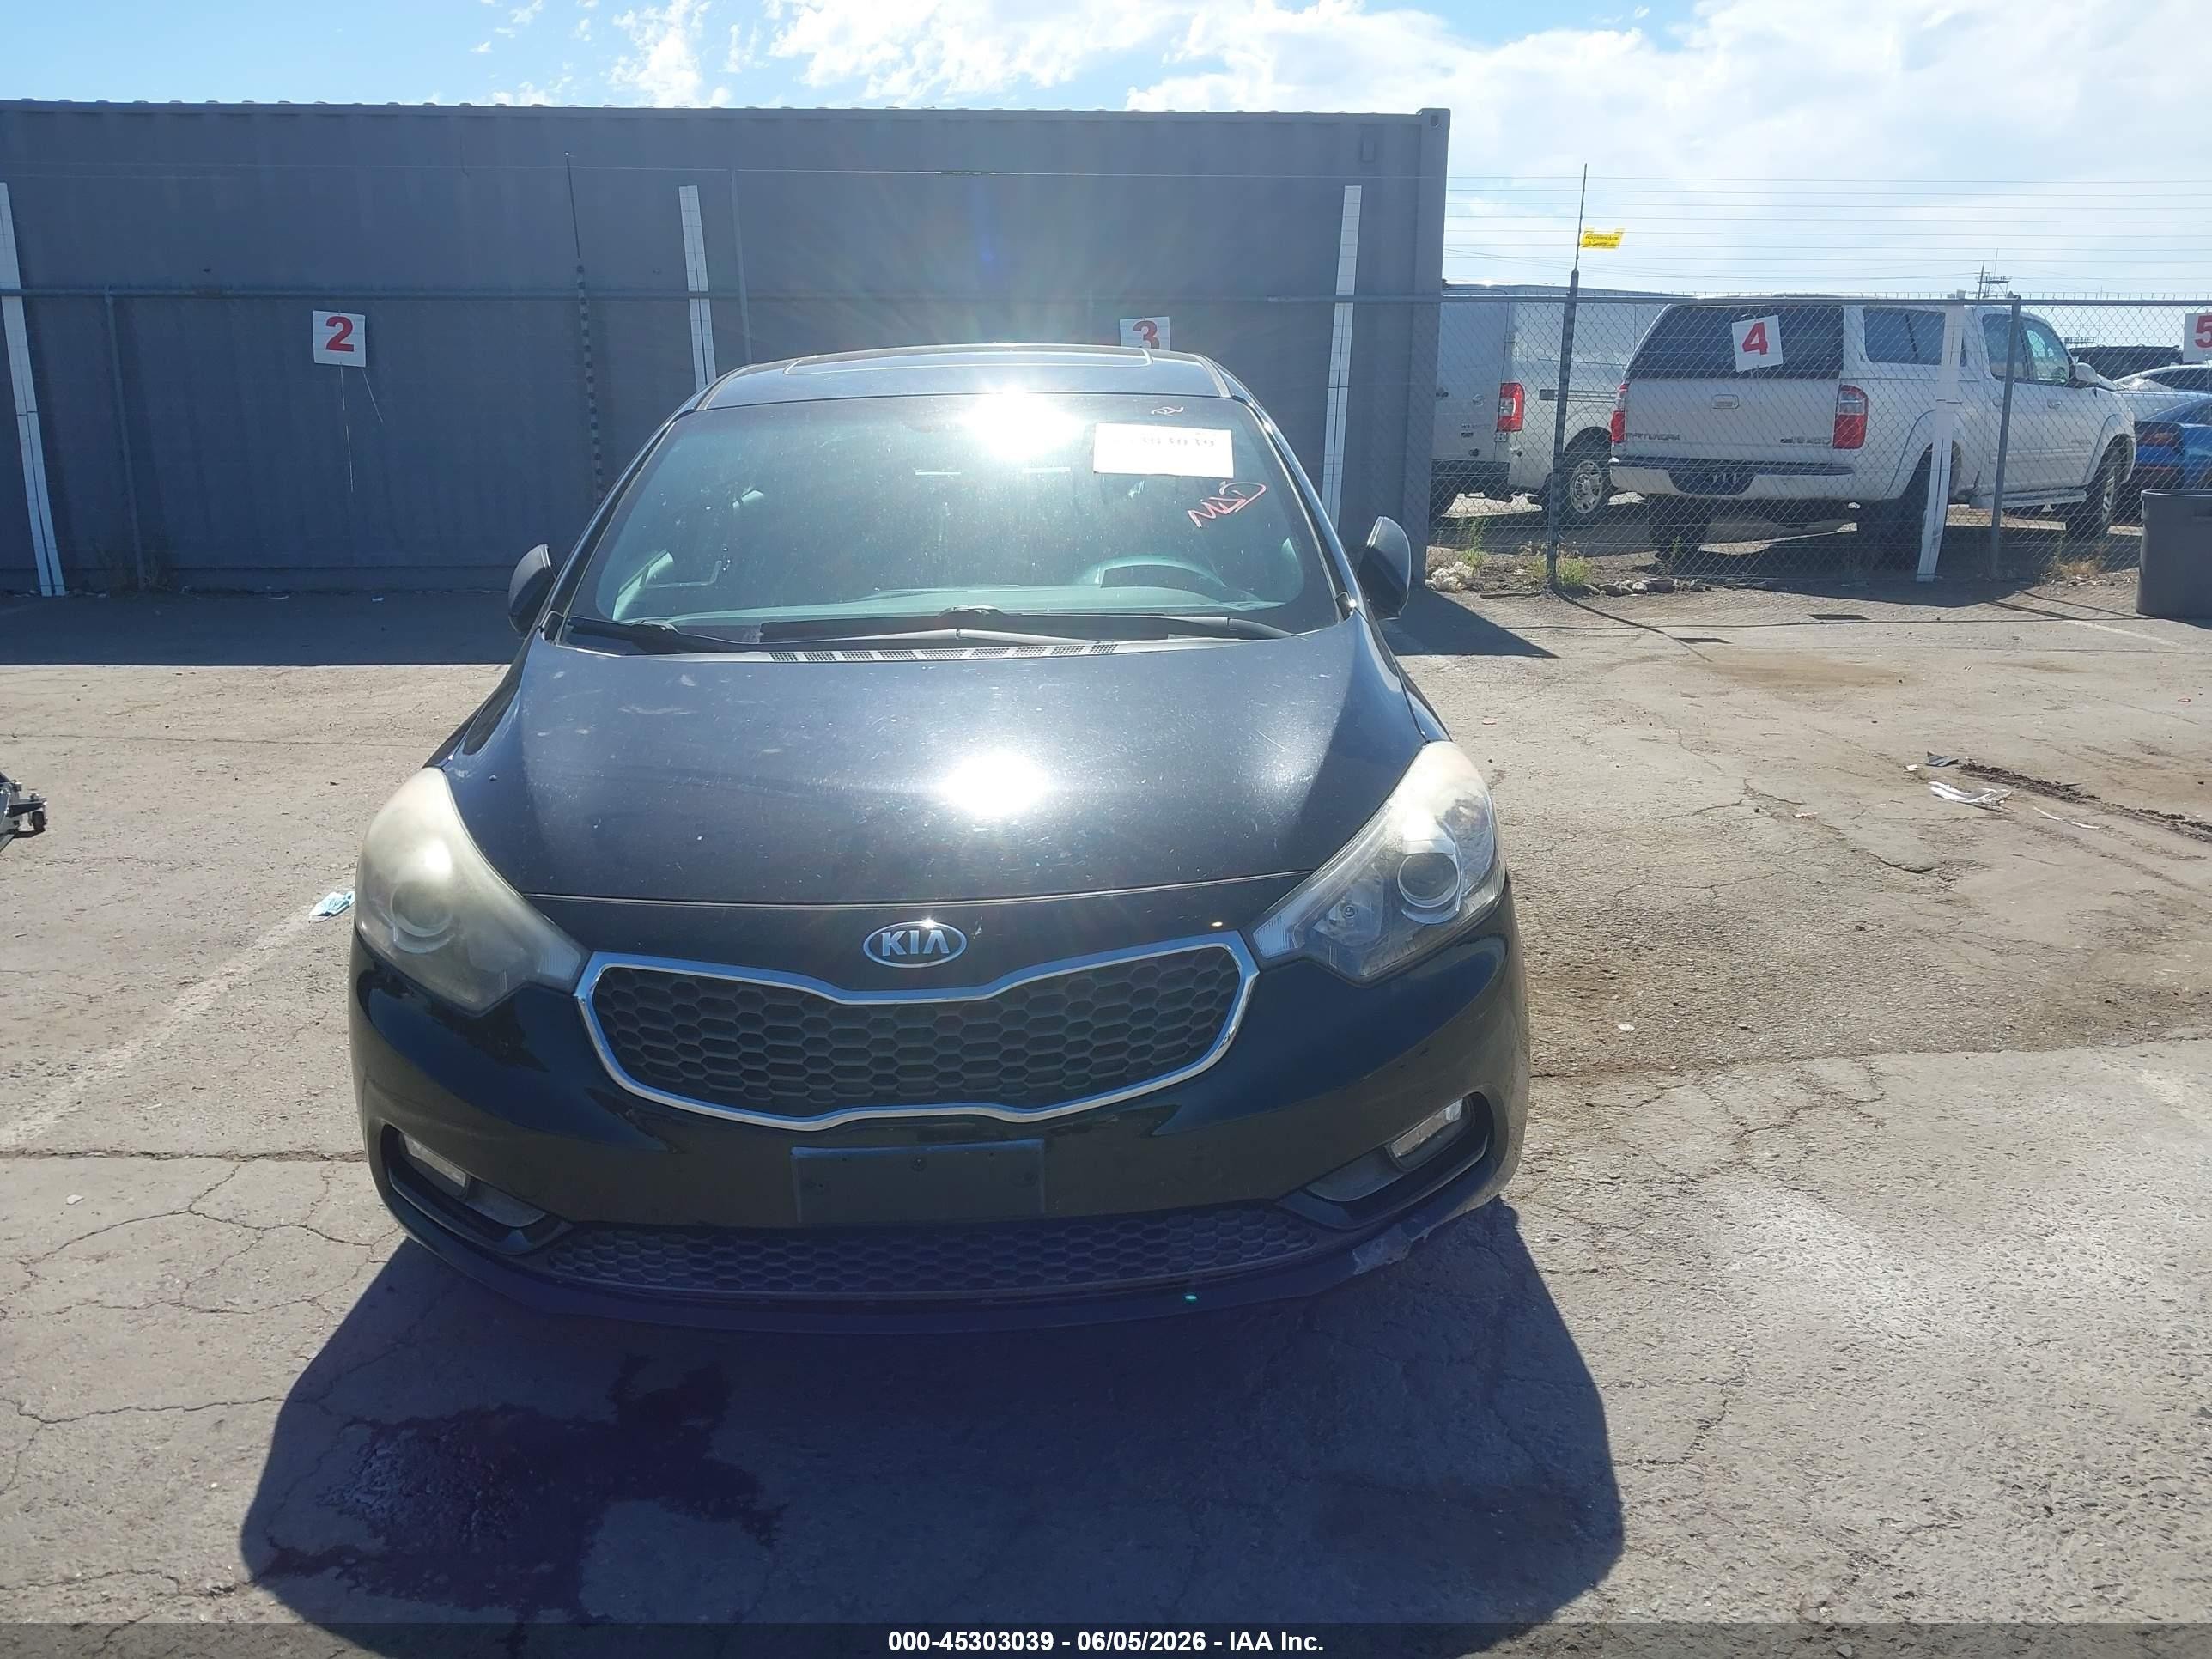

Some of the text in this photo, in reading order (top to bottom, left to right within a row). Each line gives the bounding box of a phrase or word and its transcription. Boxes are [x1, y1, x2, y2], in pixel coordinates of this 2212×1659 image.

[325, 315, 355, 352] 2
[1133, 320, 1160, 349] 3
[1741, 321, 1769, 356] 4
[2194, 315, 2212, 349] 5
[881, 929, 950, 957] KIA
